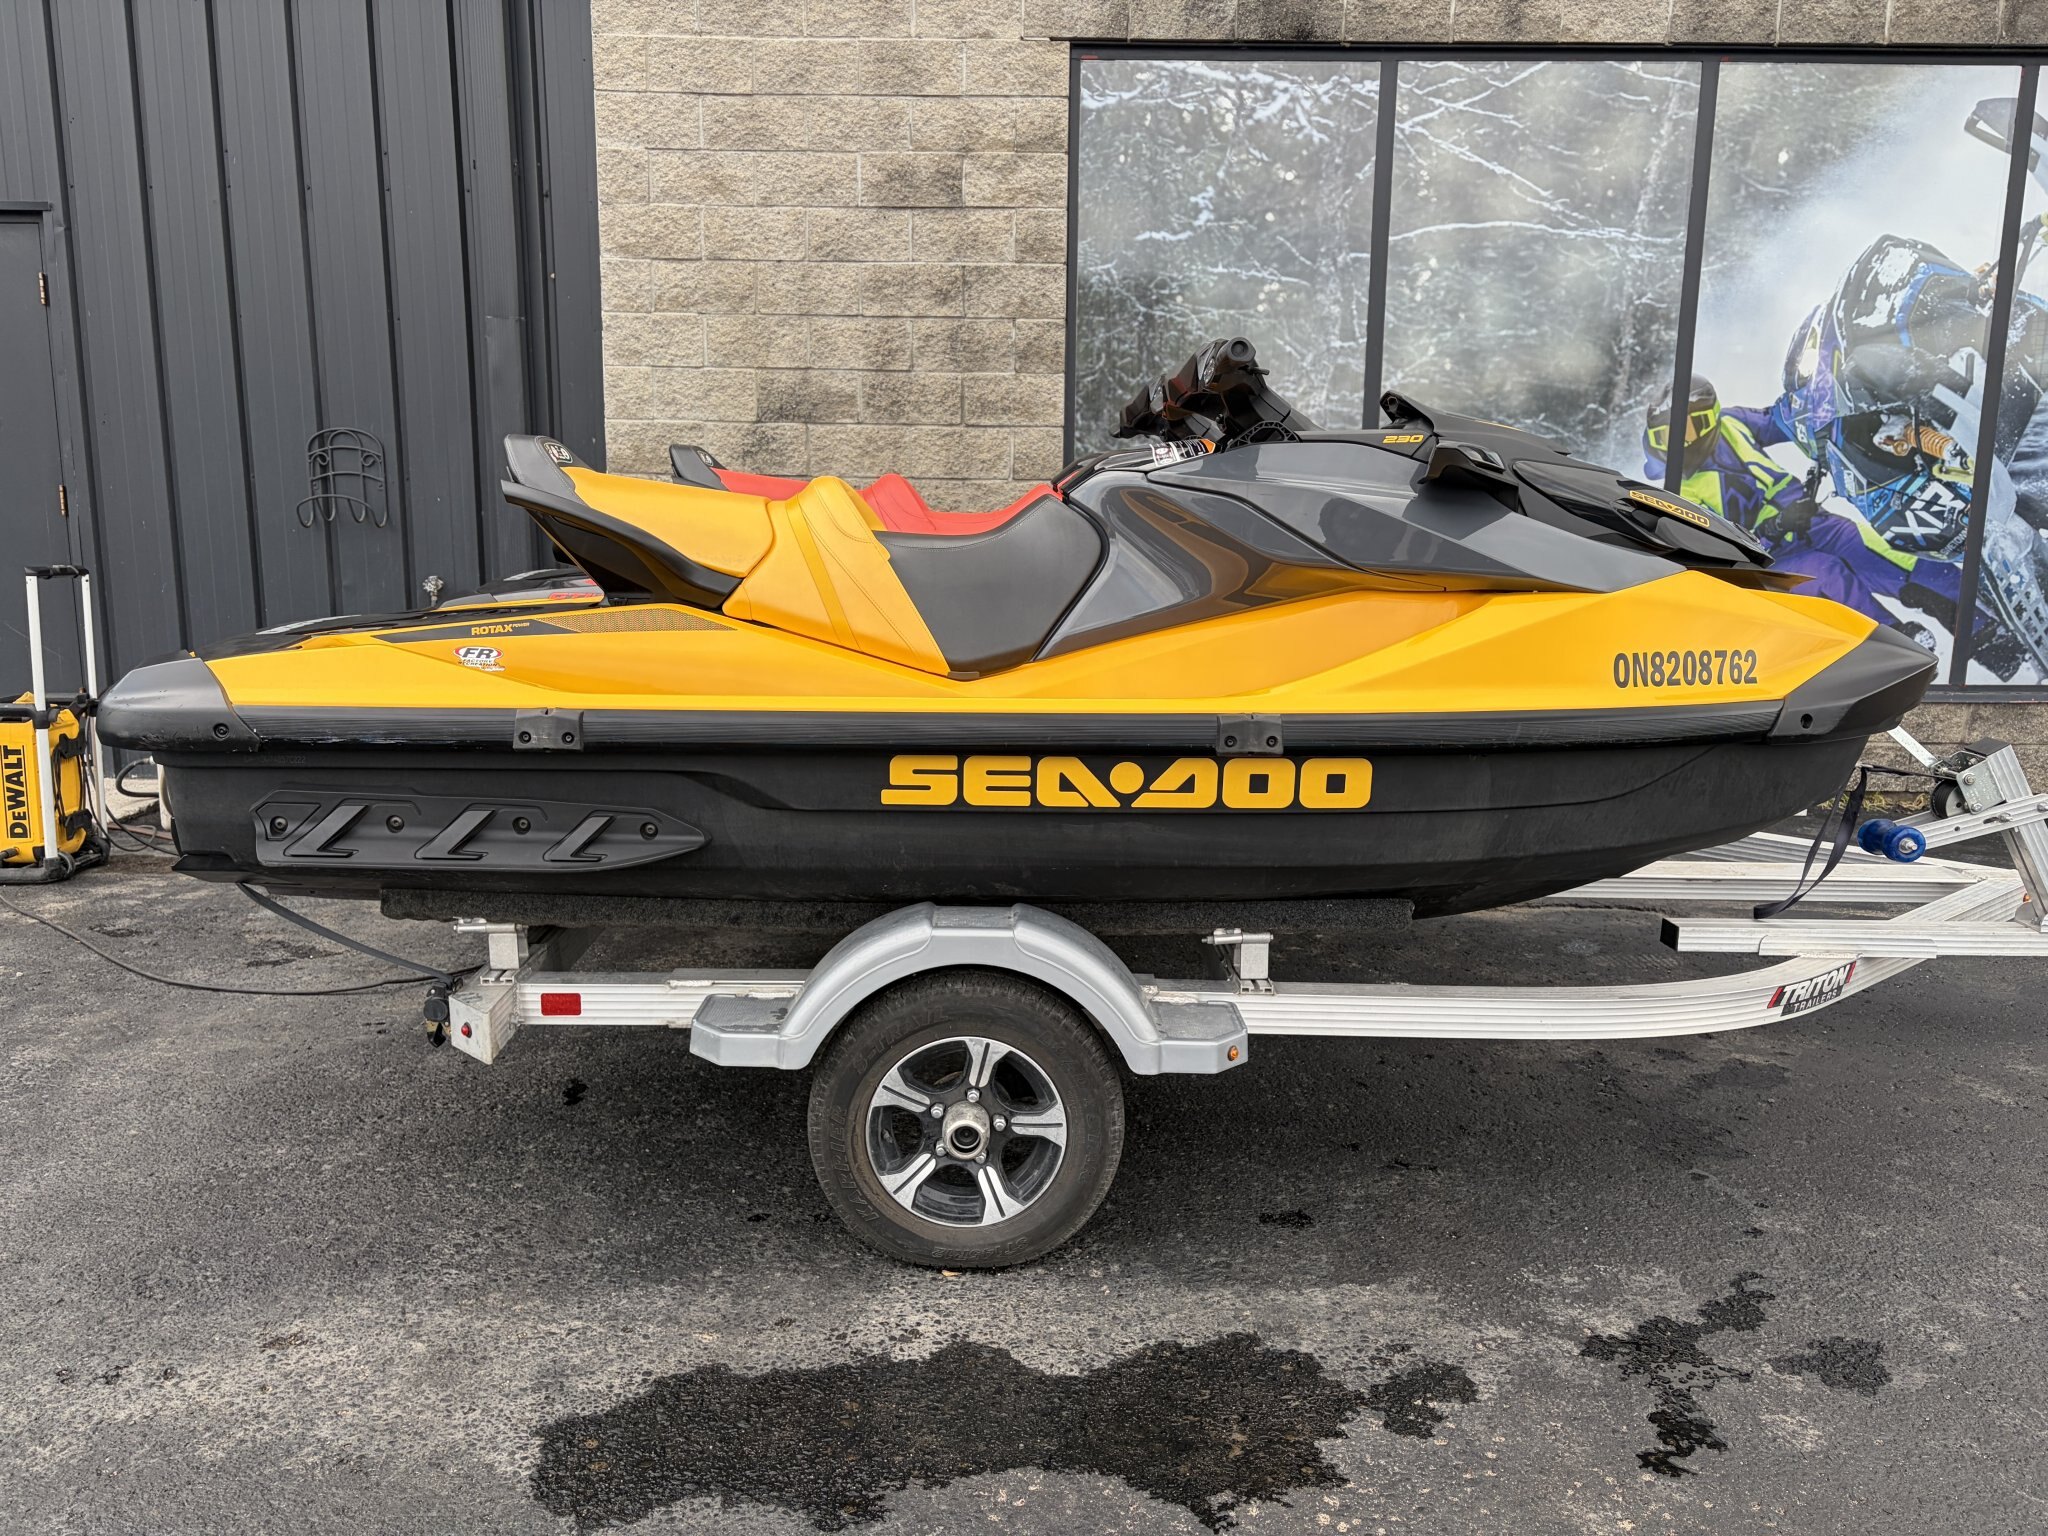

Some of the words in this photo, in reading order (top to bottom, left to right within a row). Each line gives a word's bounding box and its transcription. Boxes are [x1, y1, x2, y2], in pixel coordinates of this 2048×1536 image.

[1382, 434, 1425, 444] 230
[471, 623, 513, 636] ROTAX
[461, 647, 494, 658] FR
[1613, 649, 1758, 688] ON8208762
[1780, 964, 1851, 1006] TRITON
[1793, 989, 1838, 1013] TRAILERS
